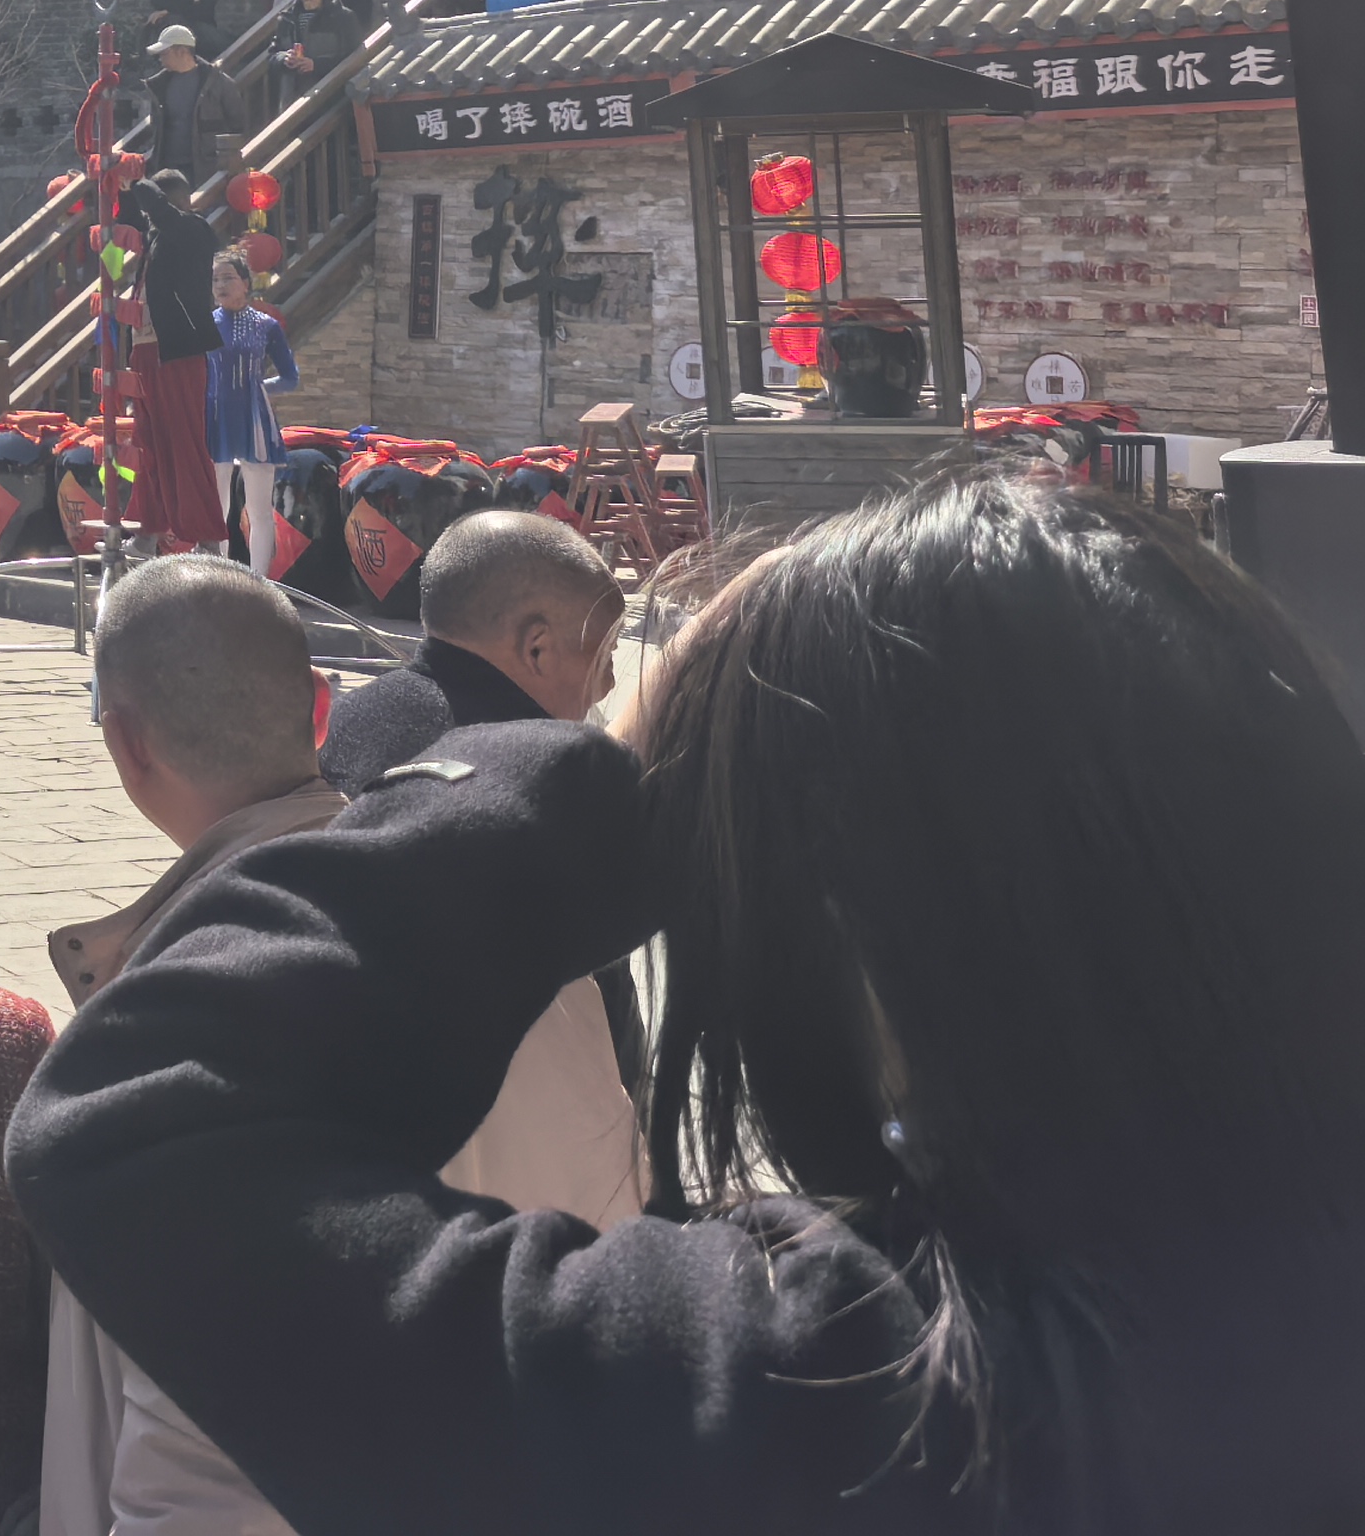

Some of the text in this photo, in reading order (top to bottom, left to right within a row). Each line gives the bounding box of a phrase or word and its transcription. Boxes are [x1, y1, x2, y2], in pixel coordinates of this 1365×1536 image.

[415, 93, 635, 141] 喝了摔碗酒
